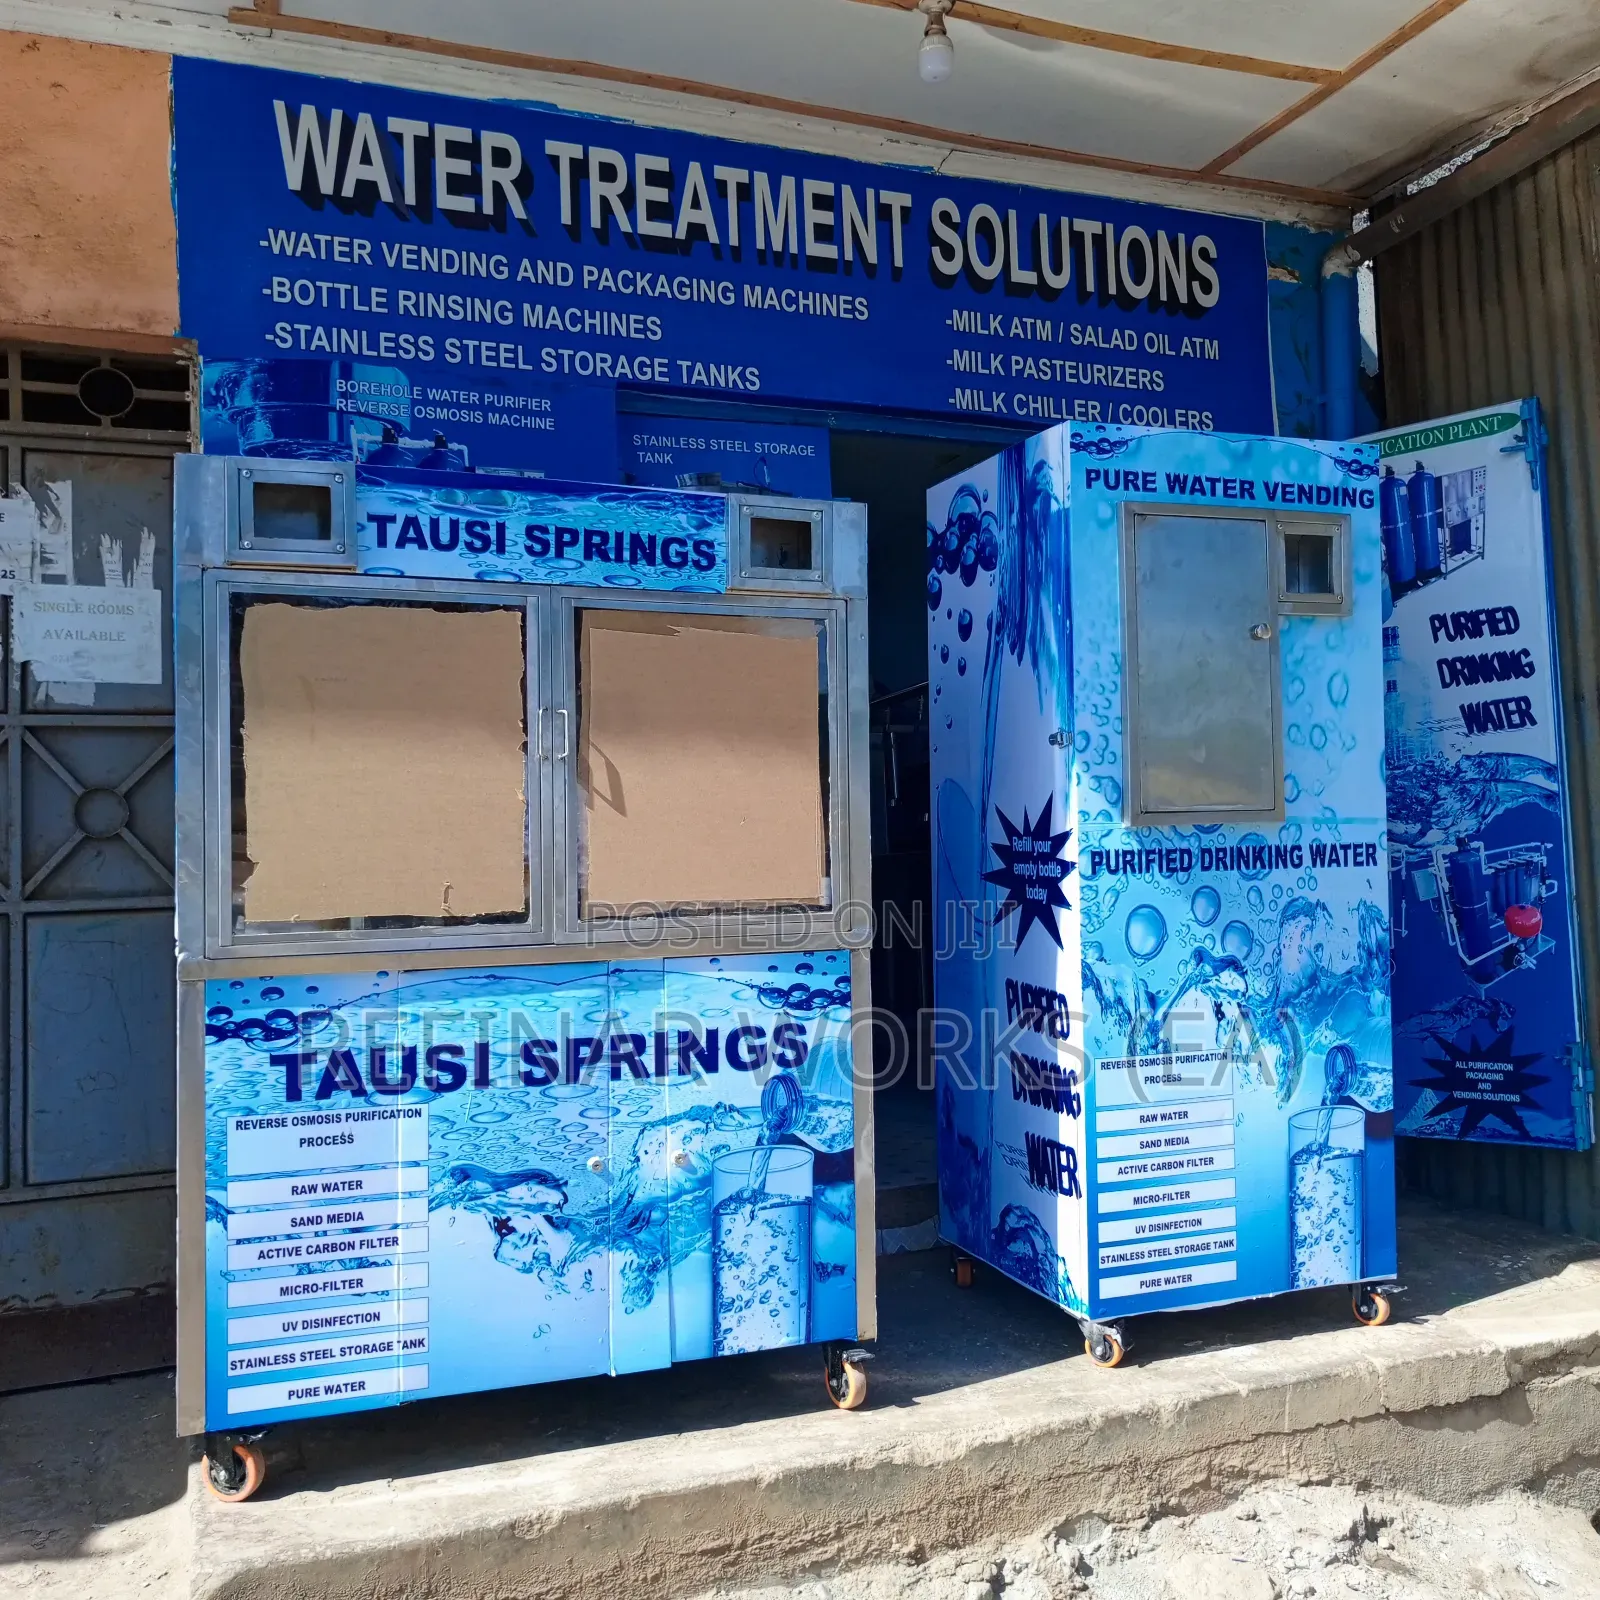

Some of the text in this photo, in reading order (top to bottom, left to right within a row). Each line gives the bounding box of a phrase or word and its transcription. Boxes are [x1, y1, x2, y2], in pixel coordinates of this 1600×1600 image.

[273, 99, 1220, 308] WATER TREATMENT SOLUTIONS
[259, 228, 869, 321] -WATER VENDING AND PACKAGING MACHINES
[262, 276, 662, 341] -BOTTLE RINSING MACHINES
[945, 309, 1220, 360] -MILK ATM / SALAD OIL ATM
[265, 322, 761, 391] -STAINLESS STEEL STORAGE TANKS
[946, 348, 1165, 392] -MILK PASTEURIZERS
[336, 379, 552, 412] BOREHOLE WATER PURIFIER
[336, 399, 555, 430] REVERSE OSMOSIS MACHINE
[948, 387, 1214, 431] -MILK CHILLER / COOLERS
[633, 434, 816, 456] STAINLESS STEEL STORAGE
[1378, 416, 1502, 455] ICATION PLANT
[637, 452, 673, 464] TANK
[1085, 467, 1375, 509] PURE WATER VENDING
[366, 514, 717, 572] TAUSI SPRINGS
[33, 601, 135, 616] SINGLE ROOMS
[43, 629, 126, 642] AVAILABLE
[1429, 605, 1520, 644] PURIFIED
[1436, 648, 1536, 689] DRINKING
[1459, 695, 1538, 735] WATER
[1013, 836, 1052, 856] Refill your
[1090, 842, 1378, 875] PURIFIED DRINKING WATER
[1013, 862, 1062, 879] empty bottle
[1026, 884, 1048, 904] today
[1005, 977, 1070, 1041] PURIFIED
[269, 1022, 809, 1101] TAUSI SPRINGS
[1100, 1052, 1228, 1071] REVERSE OSMOSIS PURIFICATION
[1468, 1061, 1513, 1071] PURIFICATION
[1144, 1074, 1182, 1085] PROCESS
[1466, 1071, 1503, 1080] PACKAGING
[1478, 1082, 1492, 1090] AND
[1453, 1091, 1520, 1102] VENDING SOLUTIONS
[236, 1108, 422, 1131] REVERSE OSMOSIS PURIFICATION
[1139, 1111, 1189, 1123] RAW WATER
[299, 1133, 354, 1148] PROCESS
[1139, 1136, 1190, 1149] SAND MEDIA
[1024, 1131, 1082, 1199] WATER
[1117, 1156, 1214, 1175] ACTIVE CARBON FILTER
[291, 1180, 363, 1196] RAW WATER
[1133, 1191, 1191, 1205] MICRO-FILTER
[290, 1211, 364, 1228] SAND MEDIA
[1135, 1218, 1202, 1234] UV DISINFECTION
[257, 1236, 399, 1261] ACTIVE CARBON FILTER
[1100, 1239, 1235, 1265] STAINLESS STEEL STORAGE TANK
[279, 1278, 364, 1297] MICRO-FILTER
[1139, 1274, 1192, 1289] PURE WATER
[282, 1311, 381, 1333] UV DISINFECTION
[229, 1353, 296, 1371] STAINLESS
[299, 1349, 336, 1363] STEEL
[339, 1341, 394, 1357] STORAGE
[288, 1381, 366, 1400] PURE WATER
